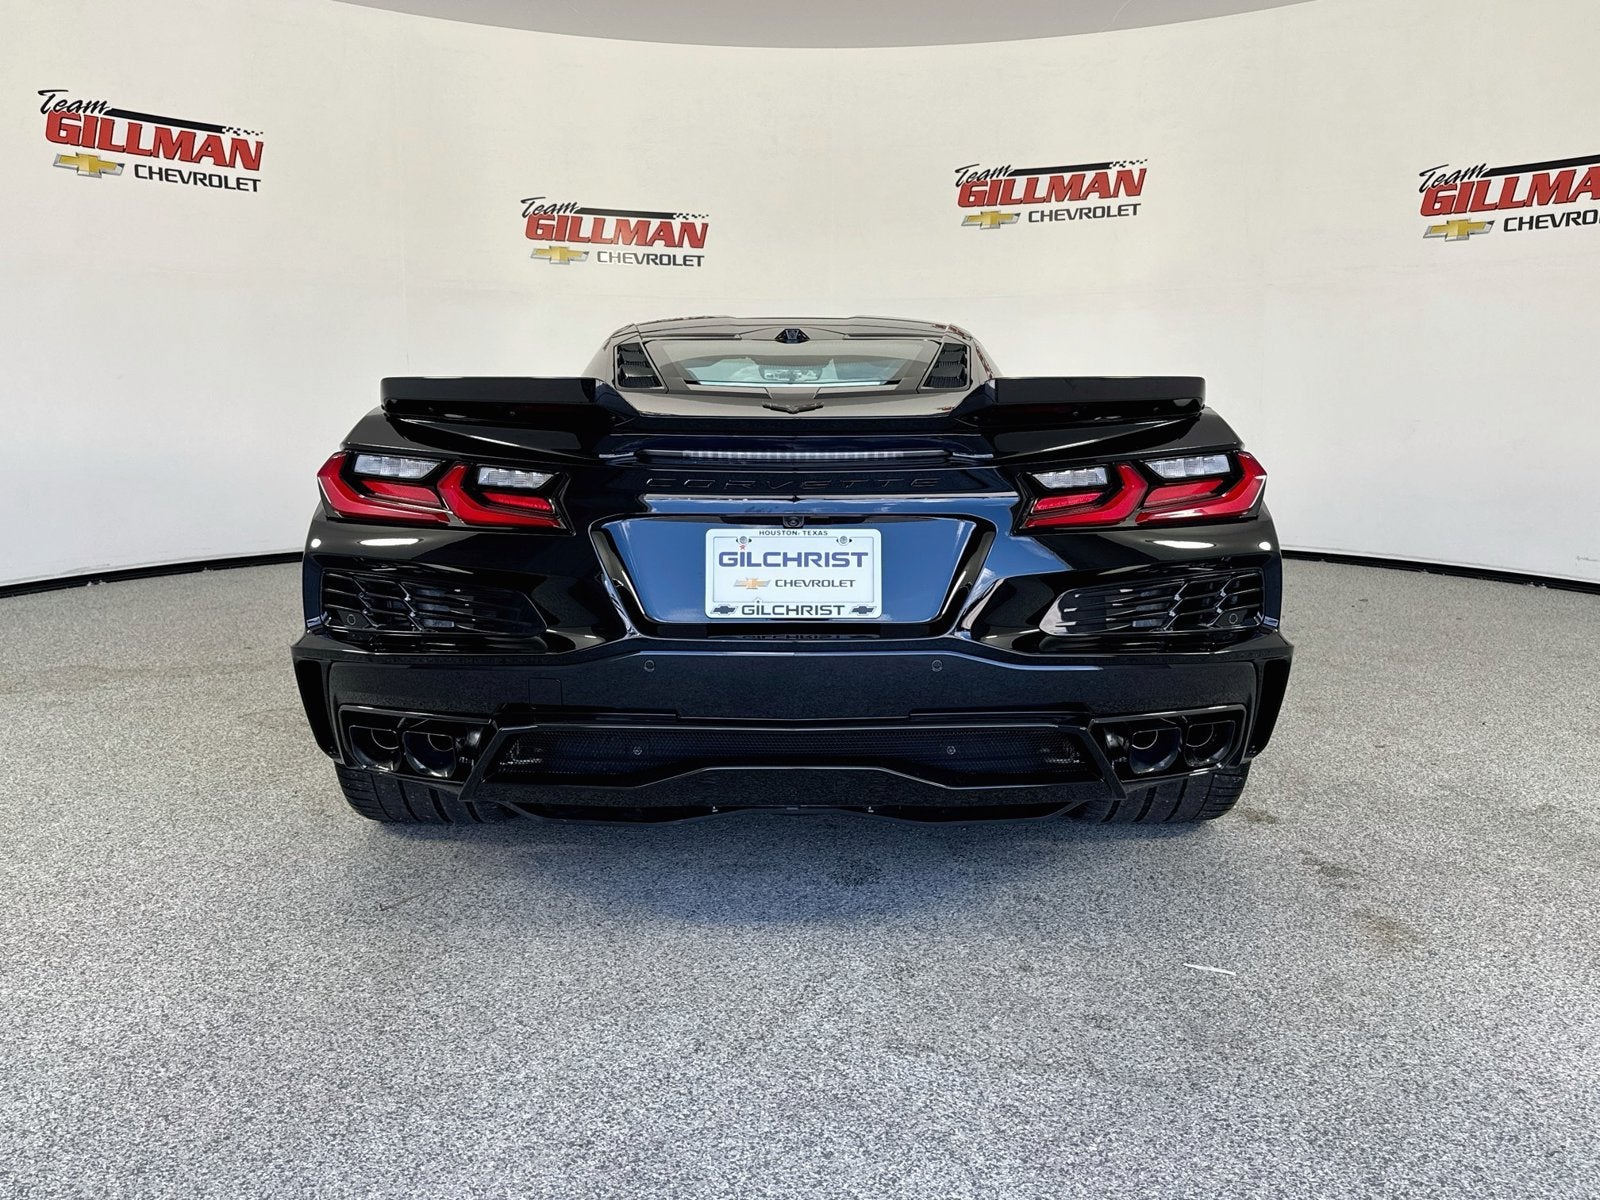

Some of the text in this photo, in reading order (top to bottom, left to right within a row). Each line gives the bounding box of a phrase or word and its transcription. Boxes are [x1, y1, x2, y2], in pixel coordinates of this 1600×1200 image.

[38, 89, 109, 115] Team
[45, 109, 264, 171] GILLMAN
[134, 164, 261, 192] CHEVROLET
[954, 164, 1013, 188] Team
[1419, 163, 1488, 193] Team
[957, 168, 1147, 208] GILLMAN
[1420, 166, 1600, 216] GILLMA
[520, 196, 578, 218] Team
[1028, 203, 1142, 223] CHEVROLET
[525, 213, 709, 248] GILLMAN
[1503, 209, 1600, 232] CHEVRO
[596, 250, 705, 267] CHEVROLET
[646, 477, 941, 490] CORVETTE
[718, 551, 869, 568] GILCHRIST
[775, 579, 856, 588] CHEVROLET
[741, 601, 845, 616] GILCHRIST
